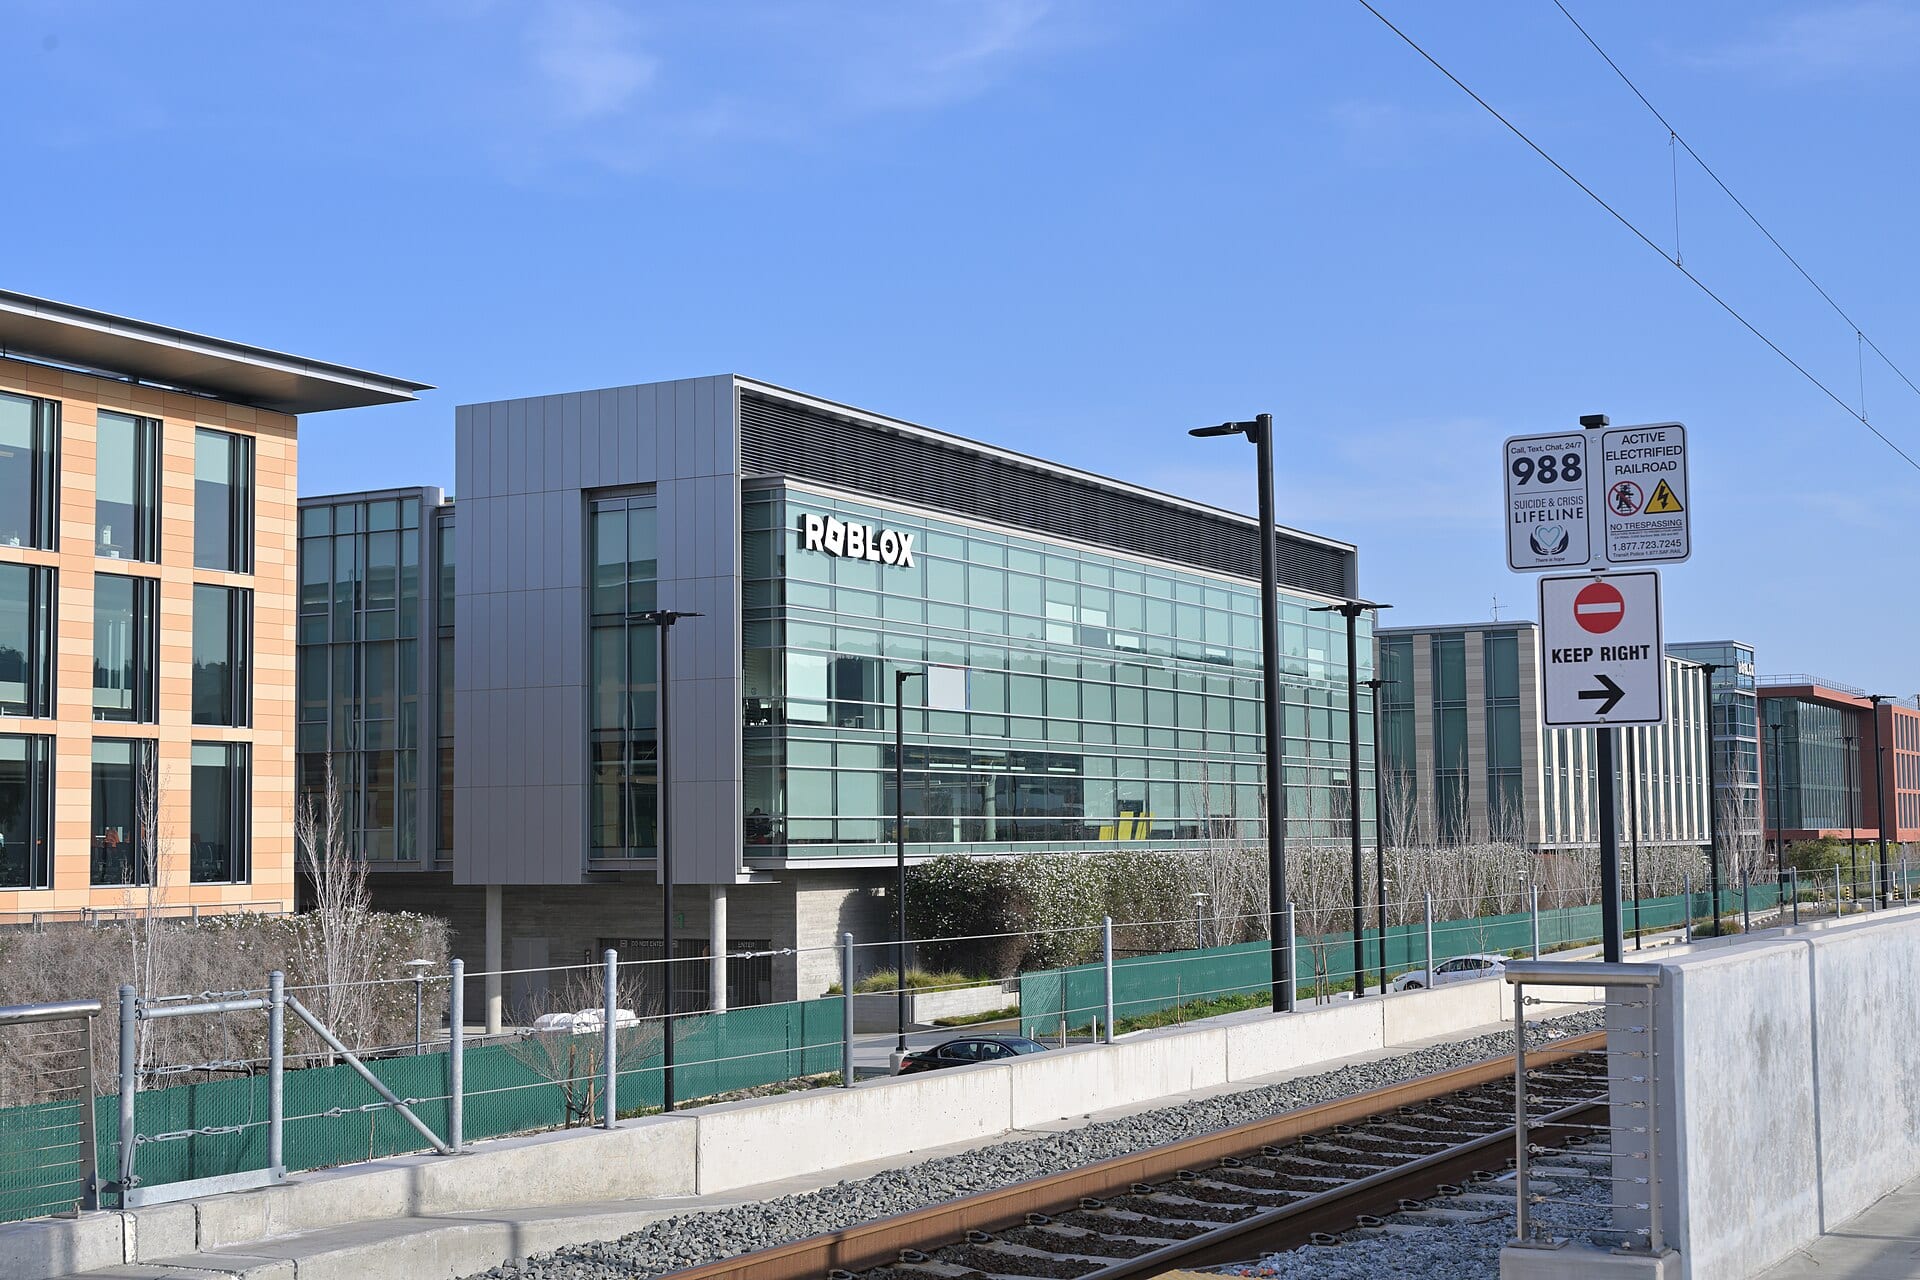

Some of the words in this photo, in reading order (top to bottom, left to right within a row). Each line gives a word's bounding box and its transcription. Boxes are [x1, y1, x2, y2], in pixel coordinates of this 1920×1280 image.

[1621, 432, 1665, 445] ACTIVE
[1606, 445, 1682, 461] ELECTRIFIED
[1512, 453, 1582, 485] 988
[1615, 460, 1677, 475] RAILROAD
[1514, 498, 1547, 510] SUICIDE
[1548, 498, 1555, 507] &
[1557, 496, 1584, 507] CRISIS
[1515, 507, 1584, 523] LIFELINE
[1610, 523, 1622, 531] NO
[1625, 519, 1682, 530] TRESPASSING
[802, 513, 915, 568] ROBLOX
[1613, 539, 1682, 551] 1.877.723.7245
[1552, 648, 1593, 663] KEEP
[1600, 645, 1650, 661] RIGHT
